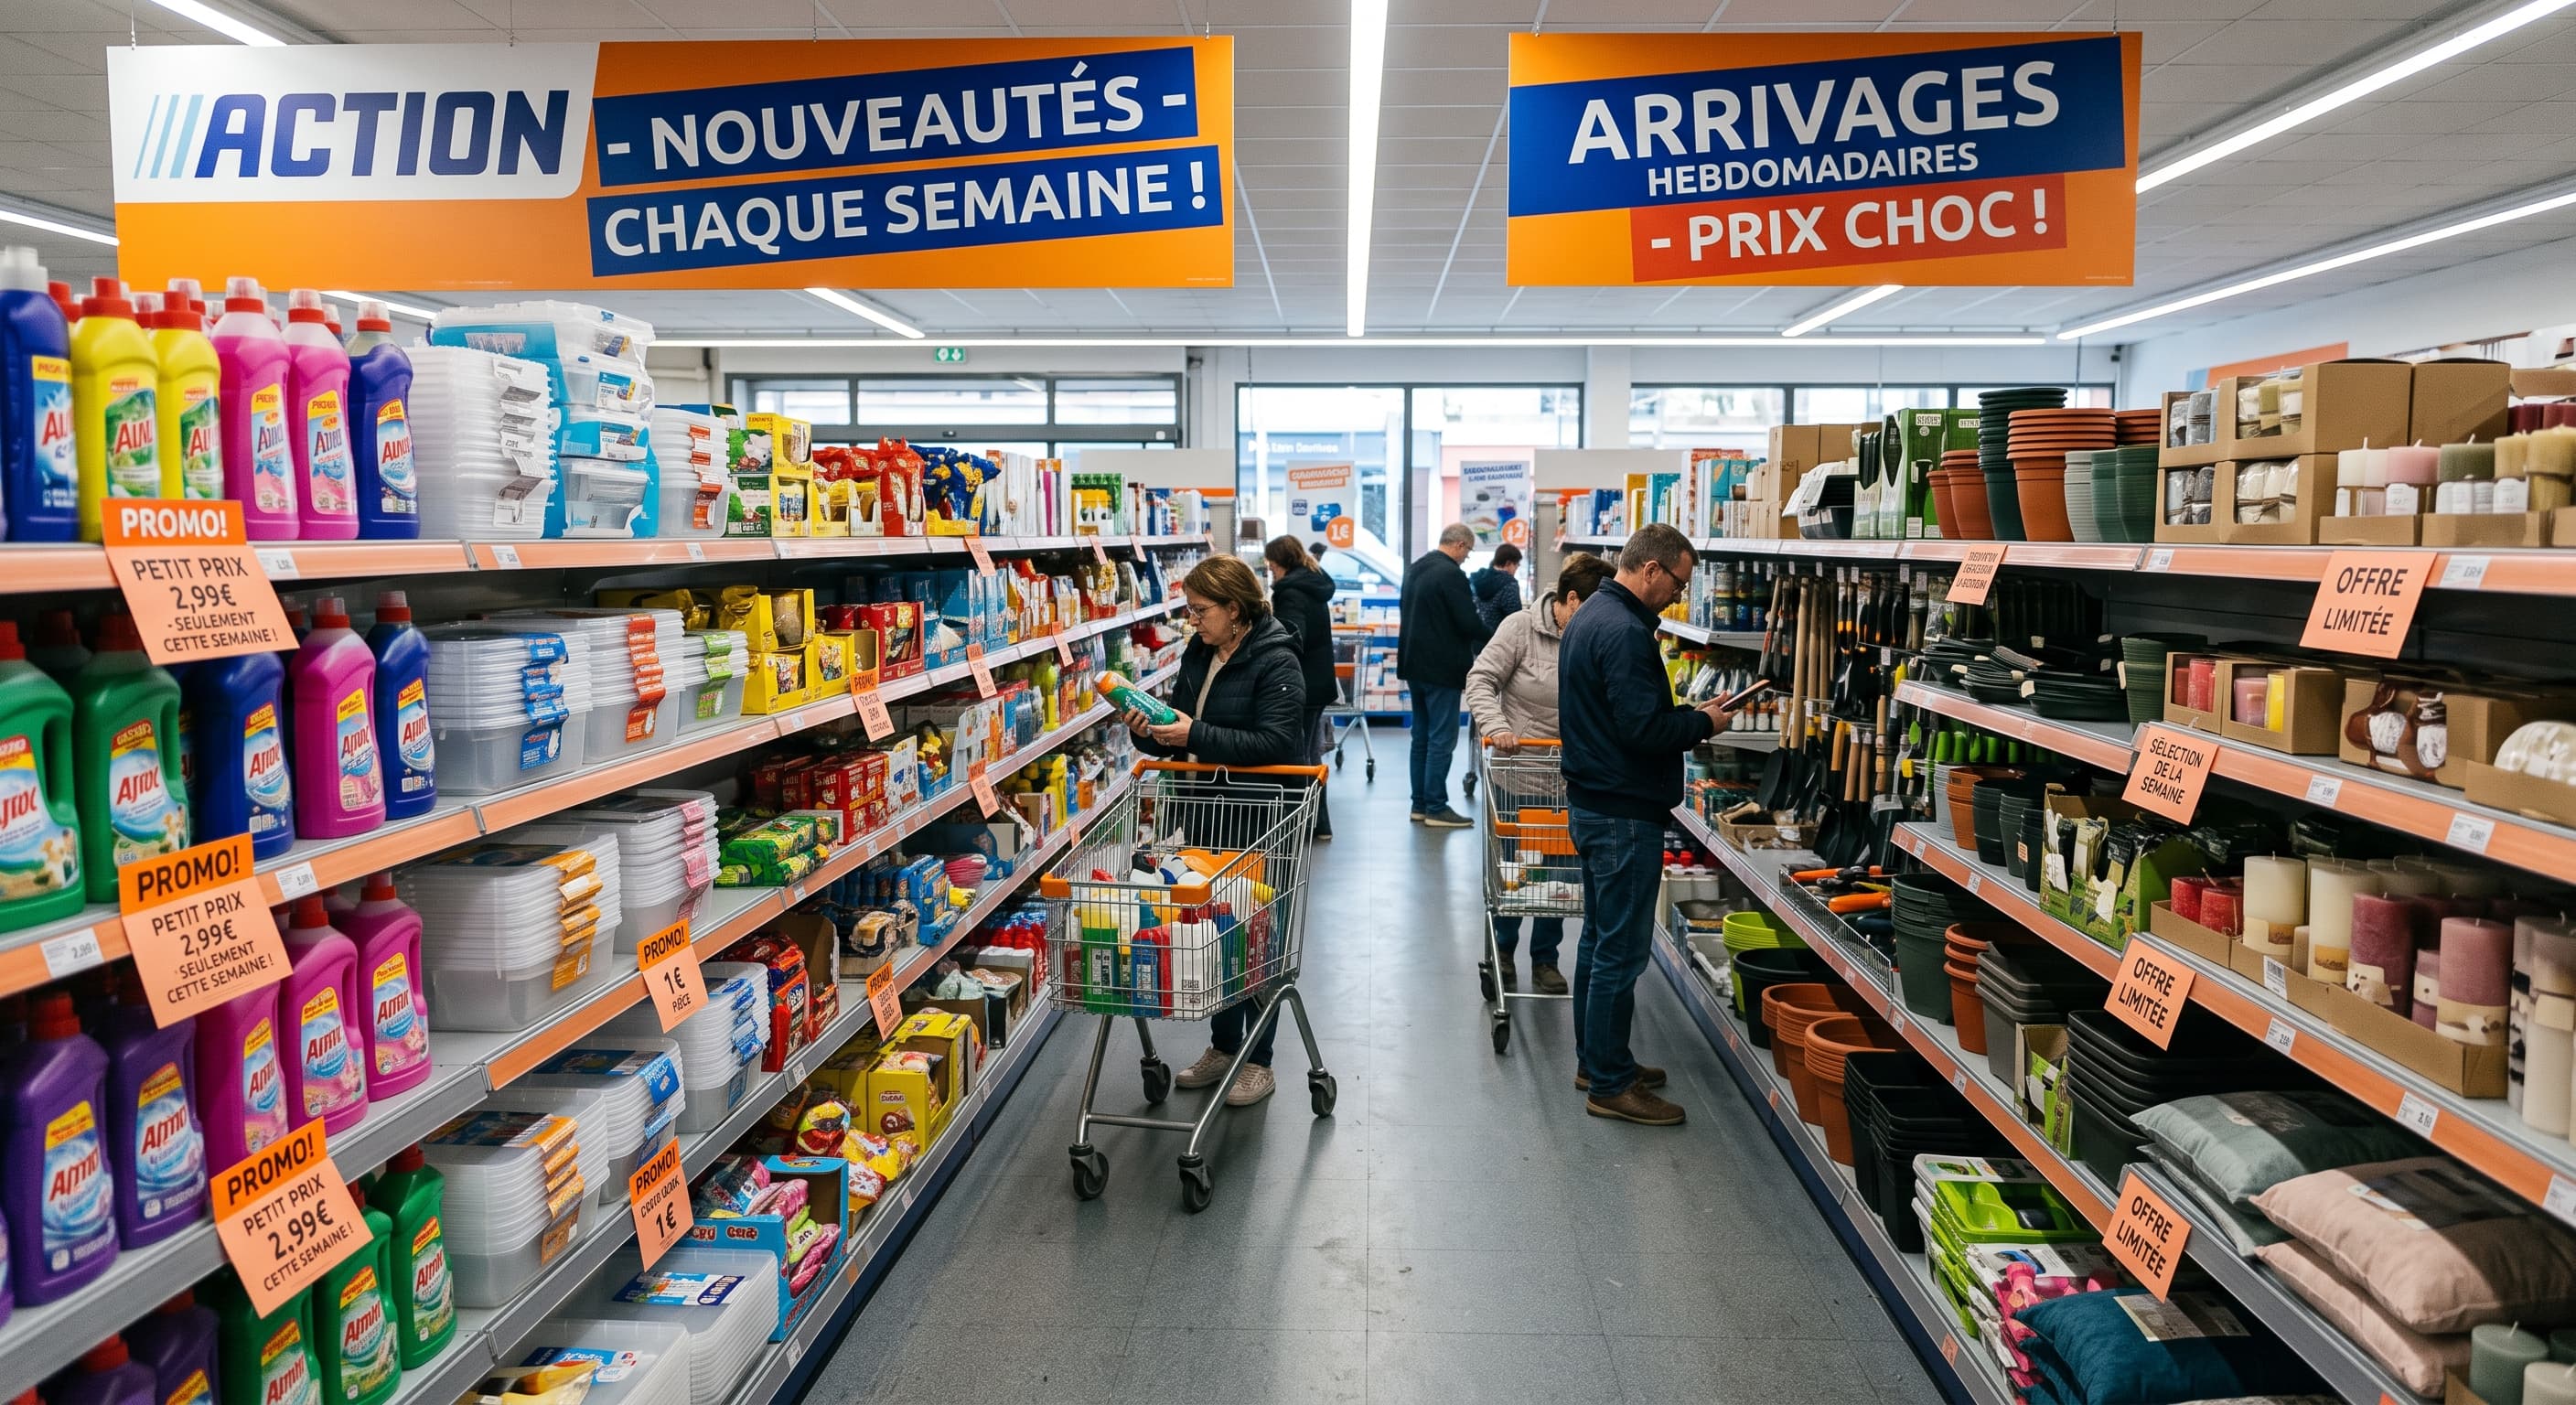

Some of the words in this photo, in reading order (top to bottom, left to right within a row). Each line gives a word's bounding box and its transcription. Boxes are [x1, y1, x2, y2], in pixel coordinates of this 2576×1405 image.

[195, 90, 569, 178] ACTION
[650, 60, 1144, 170] NOUVEAUTÉS
[1568, 60, 2060, 165] ARRIVAGES
[1648, 142, 1979, 197] HEBDOMADAIRES
[605, 191, 867, 256] CHAQUE
[886, 164, 1172, 234] SEMAINE
[1689, 206, 1828, 261] PRIX
[1843, 191, 2016, 248] CHOC
[121, 508, 228, 537] PROMO!
[131, 558, 193, 580] PETIT
[198, 557, 249, 578] PRIX
[2336, 566, 2408, 596] OFFRE
[169, 584, 237, 614] 2,99€
[2324, 606, 2393, 636] LIMITÉE
[164, 636, 209, 652] CETTE
[213, 629, 272, 648] SEMAINE
[2141, 777, 2185, 805] SEMAINE
[2153, 760, 2170, 778] DE
[2169, 765, 2183, 783] LA
[137, 845, 239, 902] PROMO!
[152, 905, 199, 936] PETIT
[205, 891, 245, 919] PRIX
[180, 919, 237, 957] 2,99€
[643, 926, 684, 963] PROMO!
[167, 979, 209, 1004] CETTE
[212, 958, 267, 988] SEMAINE
[664, 967, 685, 994] 1€
[2133, 957, 2175, 997] OFFRE
[2118, 981, 2169, 1030] LIMITÉE
[227, 1132, 315, 1206] PROMO!
[242, 1196, 286, 1236] PETIT
[288, 1174, 326, 1207] PRIX
[656, 1201, 676, 1239] 1€
[2131, 1196, 2173, 1244] OFFRE
[267, 1199, 334, 1260] 2,99€
[2116, 1219, 2166, 1280] LIMITÉE
[263, 1258, 300, 1292] CETTE
[301, 1225, 349, 1267] SEMAINE
